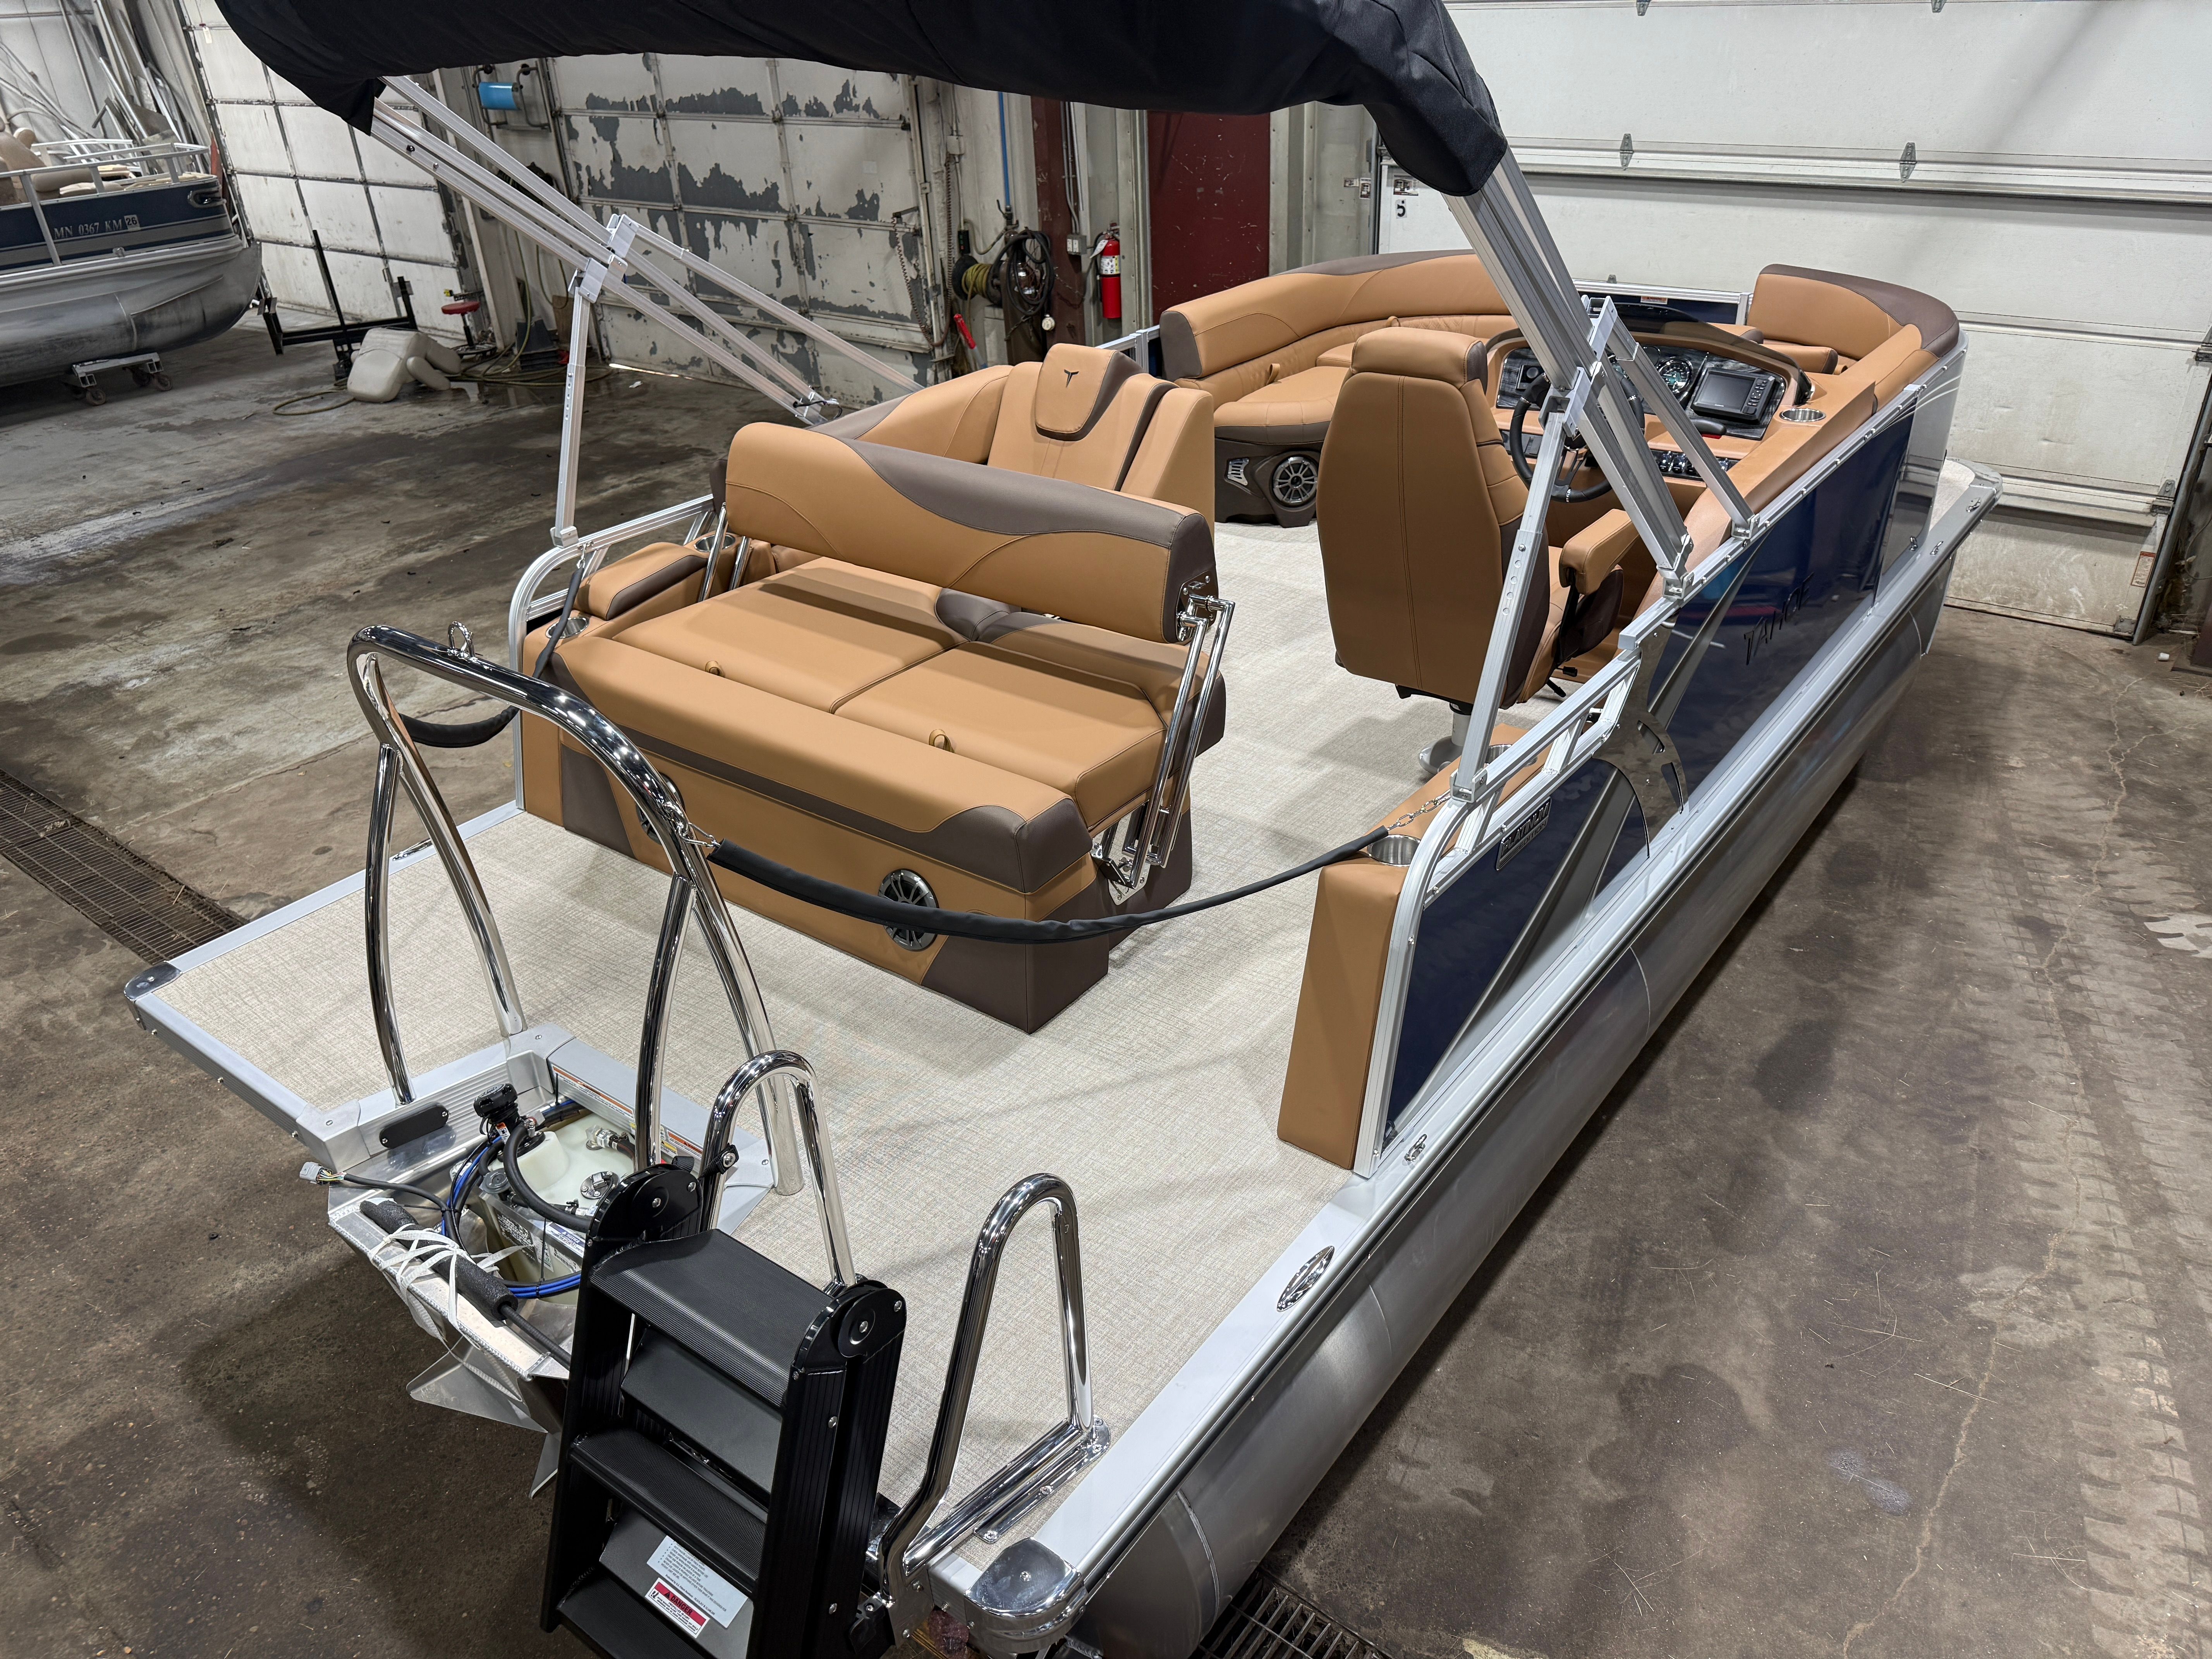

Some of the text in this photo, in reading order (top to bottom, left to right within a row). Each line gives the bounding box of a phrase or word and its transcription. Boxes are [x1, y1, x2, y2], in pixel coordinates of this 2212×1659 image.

[54, 219, 122, 239] MN 0367 KM
[126, 217, 137, 225] 26
[1501, 801, 1549, 859] PLATINUM
[1519, 821, 1546, 847] EDITION
[670, 1595, 693, 1615] DANGER
